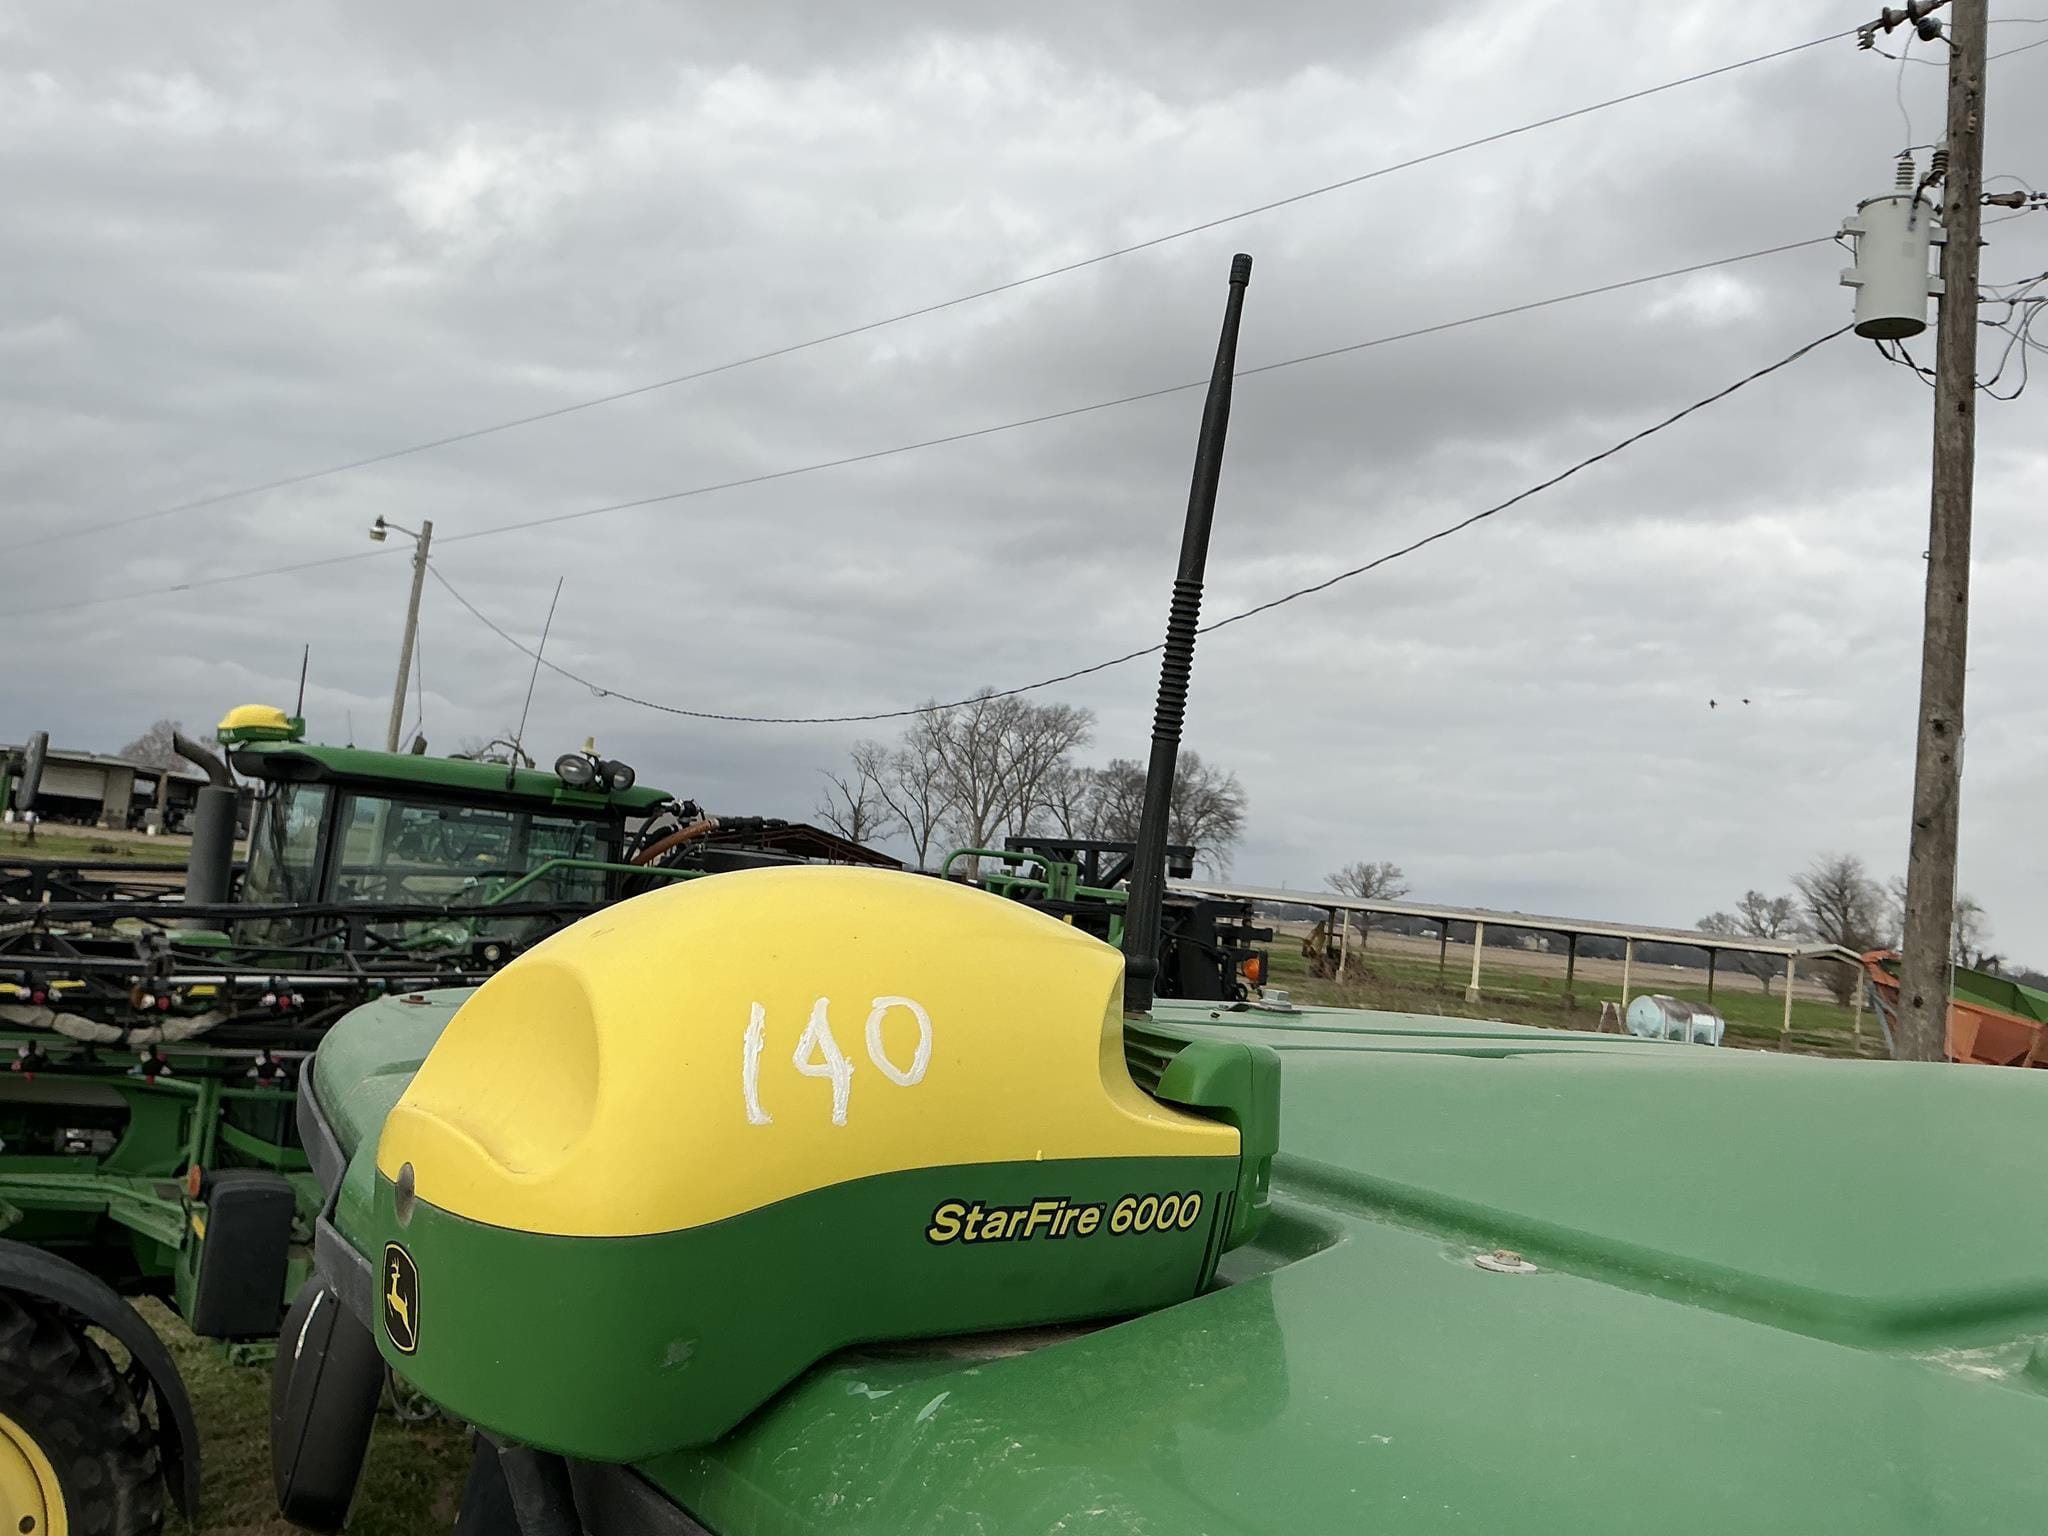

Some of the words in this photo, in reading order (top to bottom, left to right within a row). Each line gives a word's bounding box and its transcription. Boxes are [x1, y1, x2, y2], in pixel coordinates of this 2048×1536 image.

[742, 996, 933, 1126] 140
[929, 1200, 1101, 1241] StarFire
[1111, 1194, 1201, 1233] 6000
